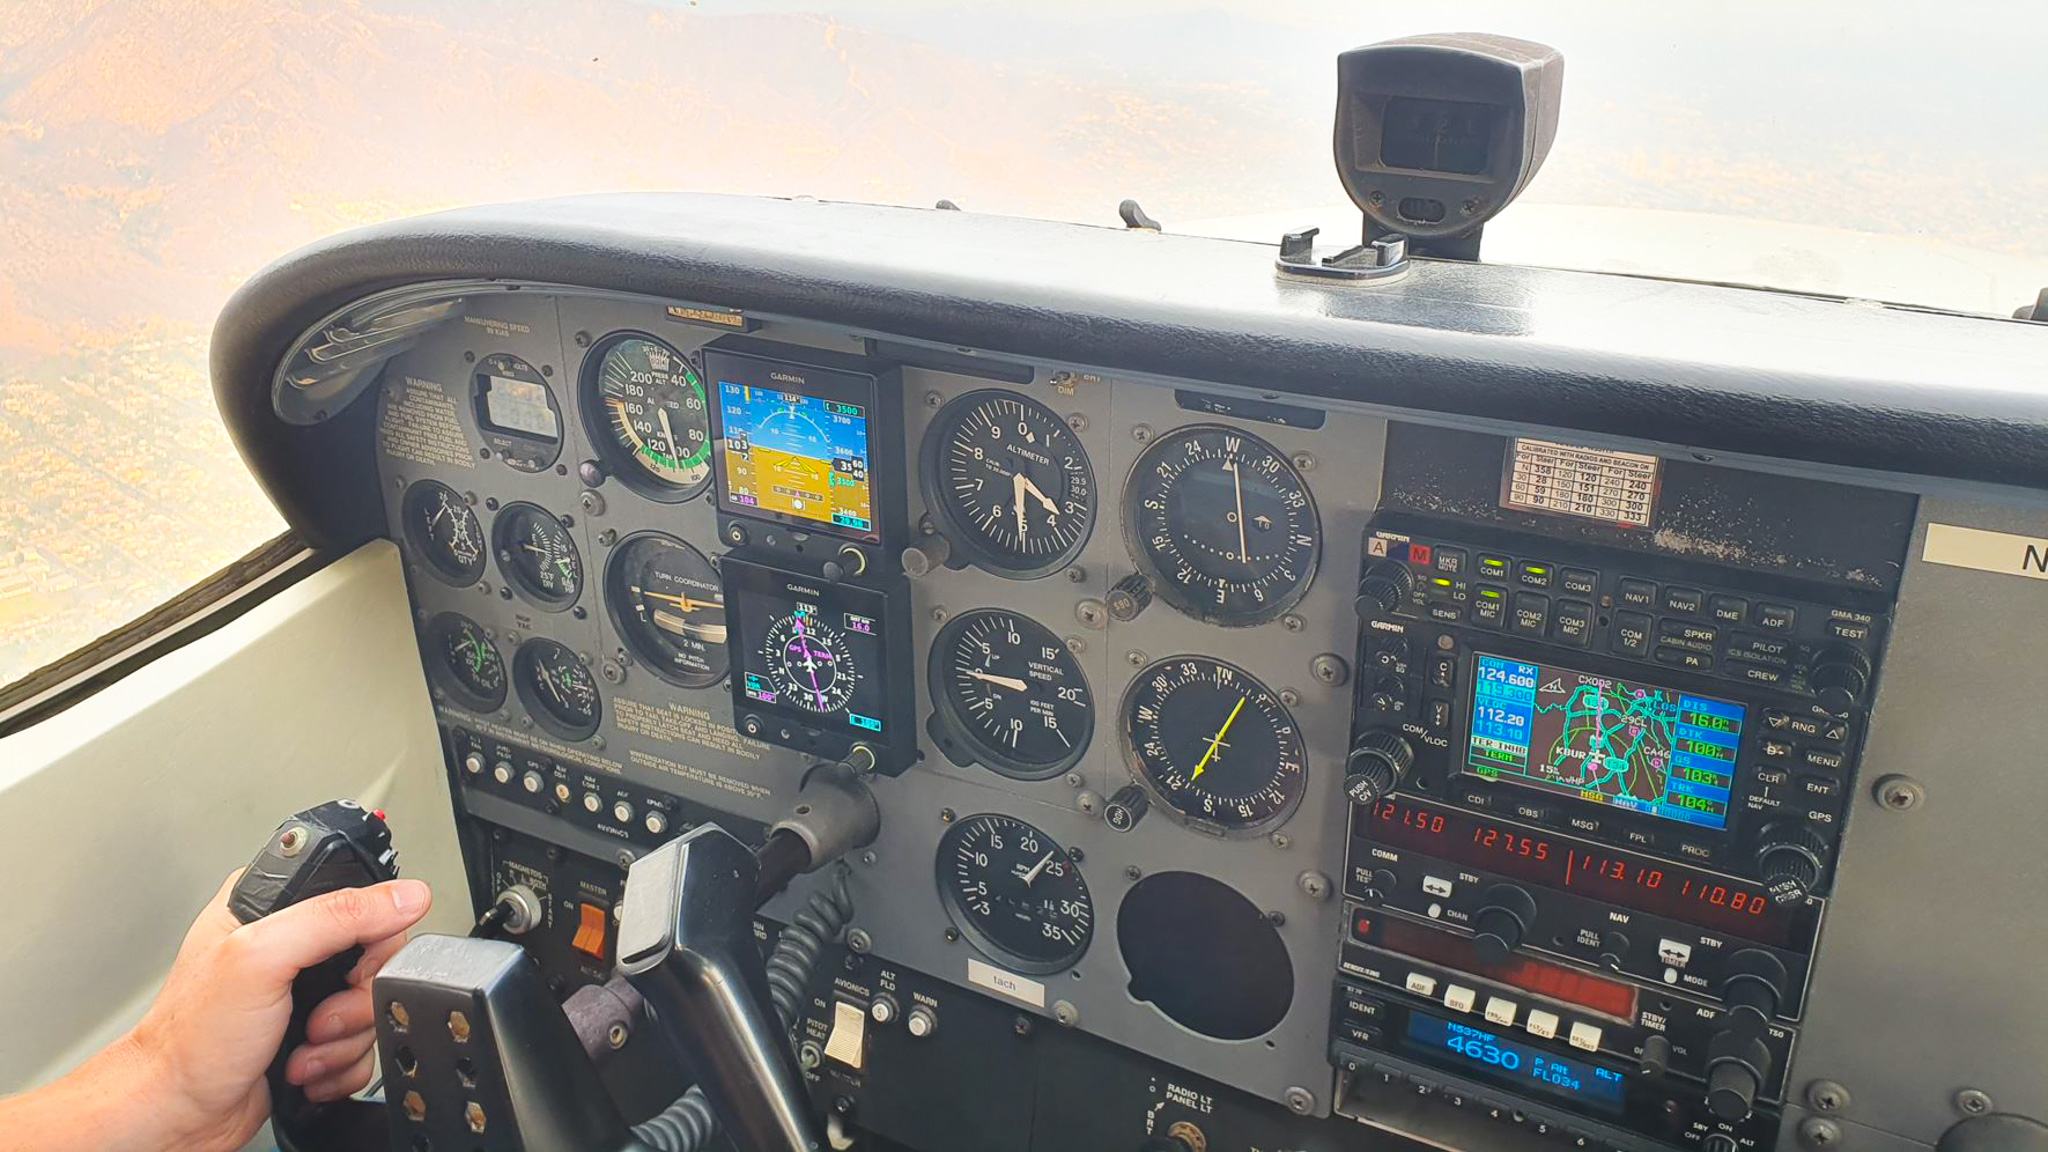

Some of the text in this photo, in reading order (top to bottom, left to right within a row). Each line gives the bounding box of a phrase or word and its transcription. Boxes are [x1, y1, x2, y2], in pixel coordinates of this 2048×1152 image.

[509, 323, 530, 333] SPEED
[630, 371, 651, 384] 200
[671, 375, 686, 387] 40
[770, 372, 805, 384] GARMIN
[405, 376, 443, 392] WARNING
[725, 385, 740, 394] 130
[626, 384, 643, 397] 180
[626, 402, 643, 415] 160
[686, 398, 701, 410] 60
[836, 405, 858, 414] 3500
[727, 406, 742, 415] 120
[833, 416, 851, 424] 3700
[634, 420, 651, 433] 140
[991, 426, 1000, 439] 9
[1018, 423, 1027, 435] 0
[689, 429, 703, 441] 80
[648, 439, 666, 451] 120
[1185, 440, 1201, 456] 24
[1225, 436, 1241, 453] W
[1522, 444, 1558, 456] CALIBRATED
[975, 448, 983, 459] 8
[1007, 444, 1050, 466] ALTIMETER
[1065, 457, 1073, 469] 2
[1262, 456, 1280, 473] 30
[737, 467, 747, 475] 90
[1156, 462, 1172, 478] 21
[975, 479, 983, 490] 7
[1581, 473, 1646, 490] 120 240
[1535, 476, 1645, 500] 28 151 270
[993, 505, 1001, 516] 6
[1065, 501, 1074, 513] 3
[1625, 501, 1643, 510] 300
[1575, 504, 1641, 521] 210 333
[1047, 515, 1056, 526] 4
[655, 571, 719, 592] TURN COORDINATOR
[1522, 575, 1547, 587] COM2
[1565, 581, 1592, 593] COM3
[787, 584, 819, 596] GARMIN
[1453, 591, 1466, 600] LO
[1669, 600, 1695, 612] NAV2
[1432, 609, 1457, 620] SENS
[1480, 610, 1495, 619] MIC
[1517, 609, 1542, 621] COM2
[1716, 610, 1738, 621] DME
[1831, 610, 1853, 621] GMA
[1520, 618, 1536, 628] MIC
[1559, 616, 1585, 628] COM3
[1762, 617, 1784, 628] ADF
[1563, 625, 1579, 635] MIC
[1620, 628, 1643, 640] COM
[1684, 628, 1713, 641] SPKR
[1835, 626, 1864, 639] TEST
[683, 640, 688, 648] 2
[1008, 632, 1020, 645] 10
[982, 643, 990, 654] 5
[1753, 642, 1783, 654] PILOT
[674, 657, 709, 671] INFORMATION
[1029, 661, 1064, 675] VERTICAL
[1685, 657, 1699, 667] PA
[1029, 670, 1052, 681] SPEED
[1181, 663, 1198, 676] 33
[1222, 669, 1233, 681] N
[1518, 665, 1534, 675] RX
[1747, 669, 1779, 682] CREW
[1479, 666, 1535, 687] 124.600
[1152, 675, 1167, 692] 30
[1058, 687, 1076, 700] 20
[985, 698, 993, 710] 5
[1684, 700, 1708, 712] DIS
[670, 702, 710, 720] WARNING
[1478, 706, 1525, 726] 112.20
[1011, 718, 1023, 731] 10
[1044, 716, 1057, 729] 15
[1620, 714, 1647, 727] 29CL
[1477, 721, 1523, 740] 113.10
[1678, 727, 1703, 739] DTK
[1792, 721, 1816, 734] RNG
[1402, 723, 1448, 747] COM/VLOC
[1484, 750, 1513, 762] TERM
[1556, 747, 1586, 759] KBUR
[1644, 746, 1670, 759] CA46
[1807, 754, 1839, 768] MENU
[1757, 772, 1779, 783] CLR
[1671, 782, 1694, 792] TRK
[1807, 783, 1830, 795] ENT
[1467, 795, 1485, 805] CDI
[1748, 795, 1780, 807] DEFAULT
[1373, 802, 1444, 834] 121.50
[1518, 806, 1538, 818] OBS
[1808, 811, 1832, 823] GPS
[1571, 818, 1594, 831] MSG
[991, 835, 1003, 849] 15
[1474, 827, 1548, 861] 127.55
[1629, 832, 1647, 844] FPL
[1020, 837, 1038, 853] 20
[1682, 844, 1710, 858] PROC
[975, 852, 987, 867] 10
[1372, 848, 1398, 862] COMM
[1046, 861, 1063, 877] 25
[1583, 855, 1664, 888] 113.10
[1459, 872, 1480, 883] STBY
[580, 880, 607, 896] MASTER
[978, 882, 987, 896] 5
[1682, 880, 1766, 915] 110.80
[564, 901, 574, 910] ON
[981, 902, 990, 915] 3
[1061, 900, 1079, 918] 30
[1447, 909, 1469, 922] CHAN
[1609, 912, 1630, 924] NAV
[1043, 923, 1061, 940] 35
[1700, 937, 1723, 948] STBY
[881, 970, 896, 980] ALT
[1683, 974, 1708, 986] MODE
[834, 977, 870, 997] AVIONICS
[880, 979, 896, 991] FLD
[993, 974, 1016, 991] tach
[814, 998, 826, 1008] ON
[913, 991, 938, 1007] WARN
[1349, 1001, 1375, 1015] IDENT
[1696, 1008, 1716, 1019] ADF
[806, 1017, 828, 1031] PITOT
[1641, 1019, 1666, 1031] TIMER
[806, 1027, 826, 1040] HEAT
[1352, 1029, 1369, 1041] VFR
[1447, 1036, 1520, 1070] 4630
[1672, 1045, 1688, 1055] VOL
[1551, 1063, 1568, 1075] Alt
[1595, 1067, 1624, 1082] ALT
[1167, 1083, 1212, 1105] RADIO LT
[1419, 1086, 1426, 1094] 2
[1166, 1091, 1212, 1113] PANEL LT
[1454, 1097, 1461, 1106] 3
[1718, 1123, 1733, 1133] ON
